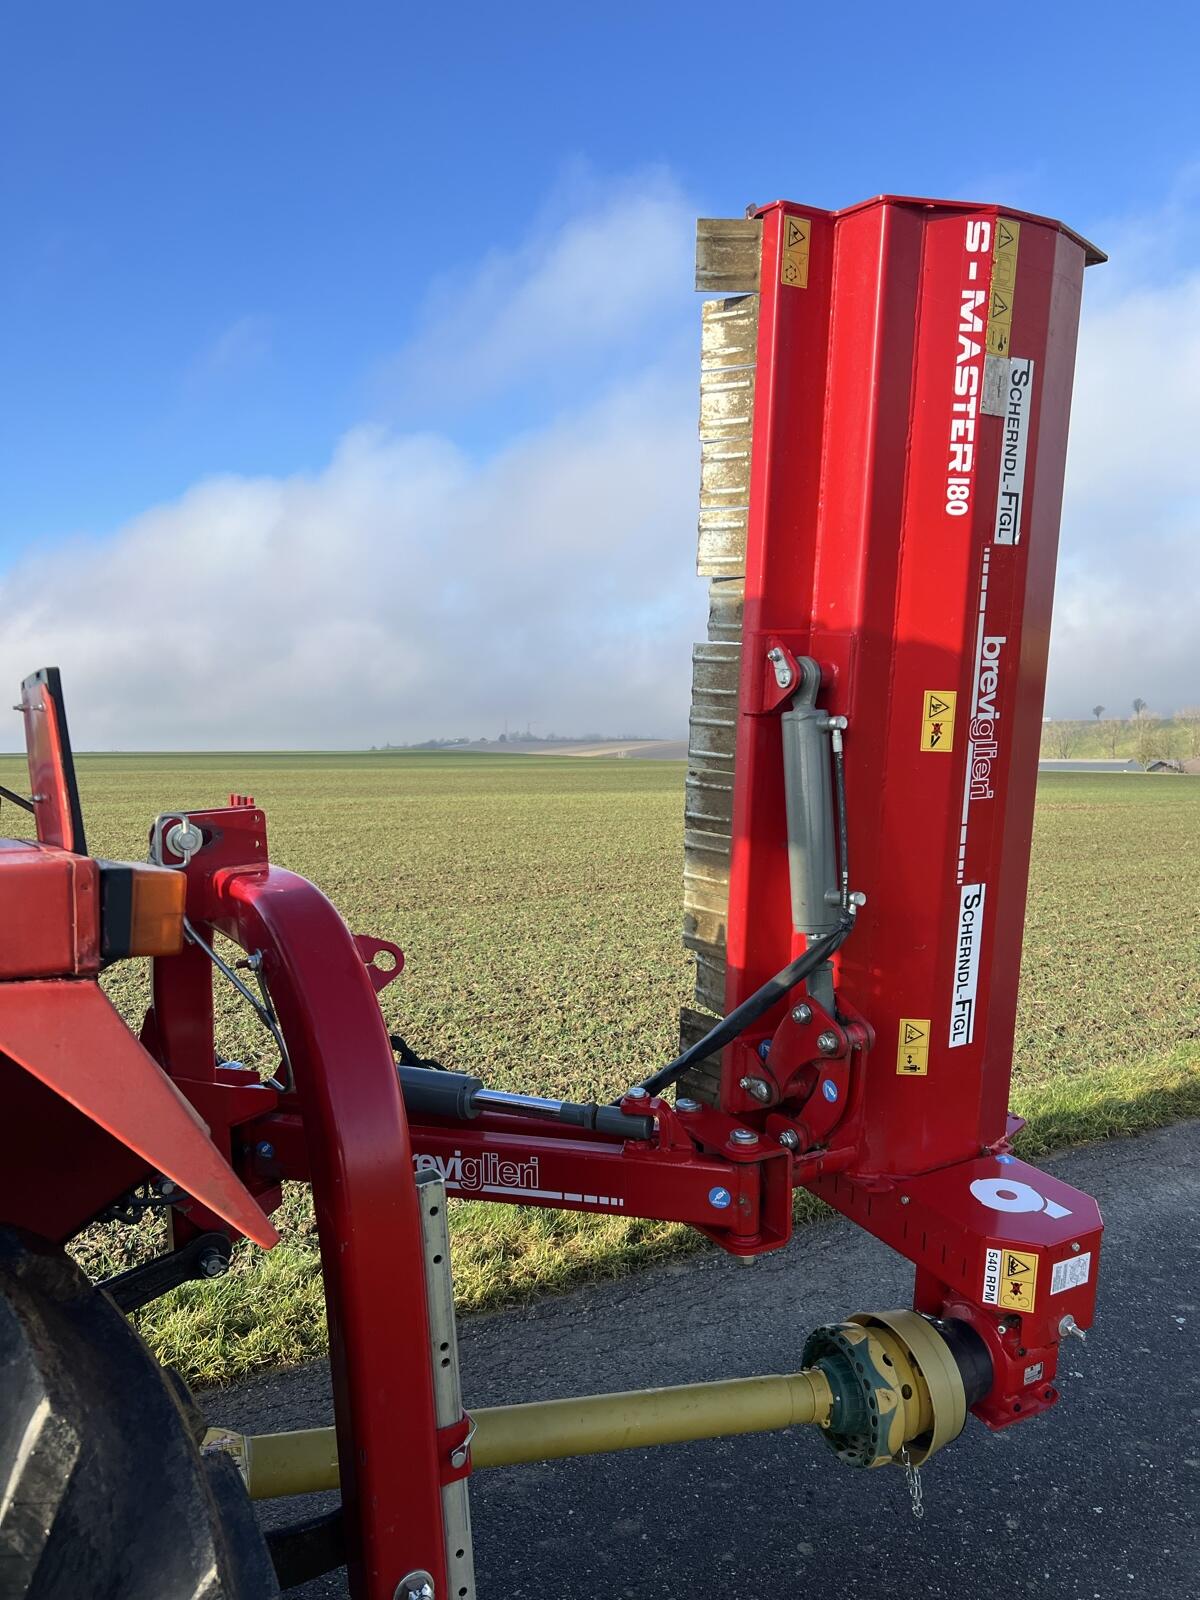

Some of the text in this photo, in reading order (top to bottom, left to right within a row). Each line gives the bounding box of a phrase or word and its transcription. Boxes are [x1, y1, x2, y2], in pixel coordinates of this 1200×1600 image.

[946, 477, 970, 516] 180
[970, 636, 1007, 800] breviglieri
[984, 1251, 998, 1302] 540 RPM
